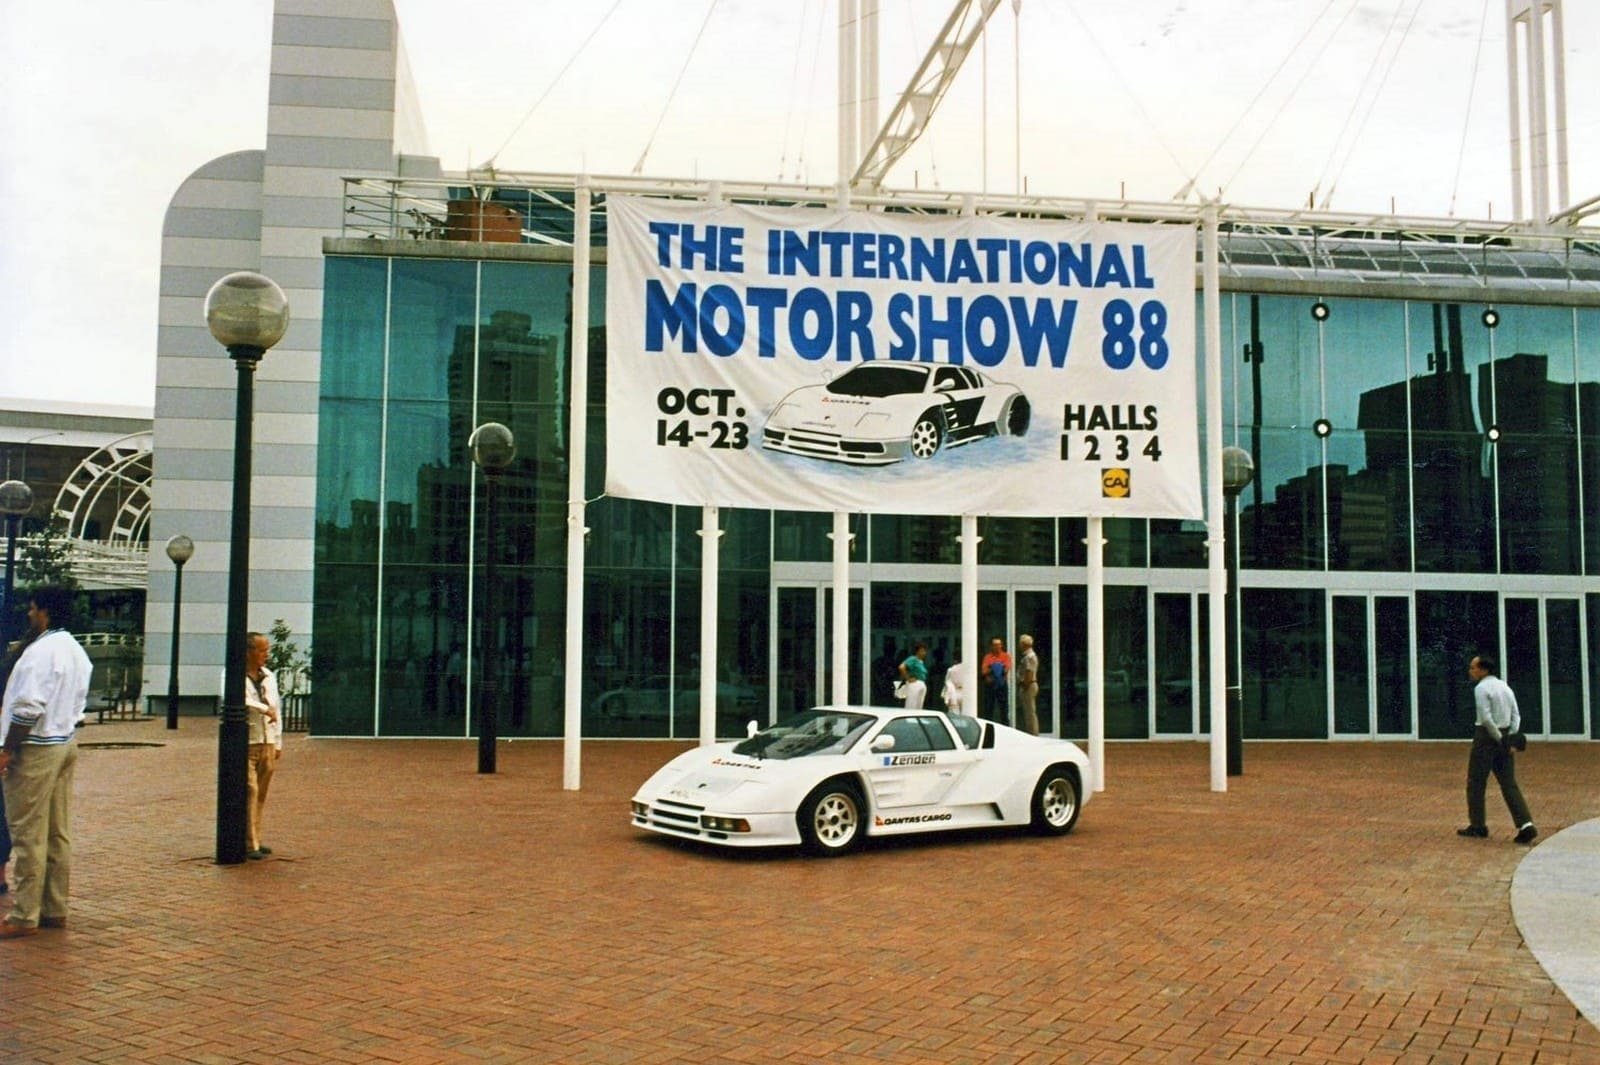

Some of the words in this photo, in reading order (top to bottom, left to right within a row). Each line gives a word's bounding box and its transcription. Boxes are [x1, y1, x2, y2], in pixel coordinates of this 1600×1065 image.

[651, 222, 744, 275] THE
[767, 230, 1155, 289] INTERNATIONAL
[645, 281, 876, 363] MOTOR
[887, 293, 1078, 369] SHOW
[1102, 298, 1169, 370] 88
[657, 387, 746, 417] OCT.
[1064, 404, 1158, 431] HALLS
[657, 419, 749, 450] 14-23
[1061, 434, 1069, 461] 1
[1084, 435, 1101, 461] 2
[1115, 434, 1129, 462] 3
[1142, 435, 1162, 462] 4
[921, 813, 952, 822] CARGO
